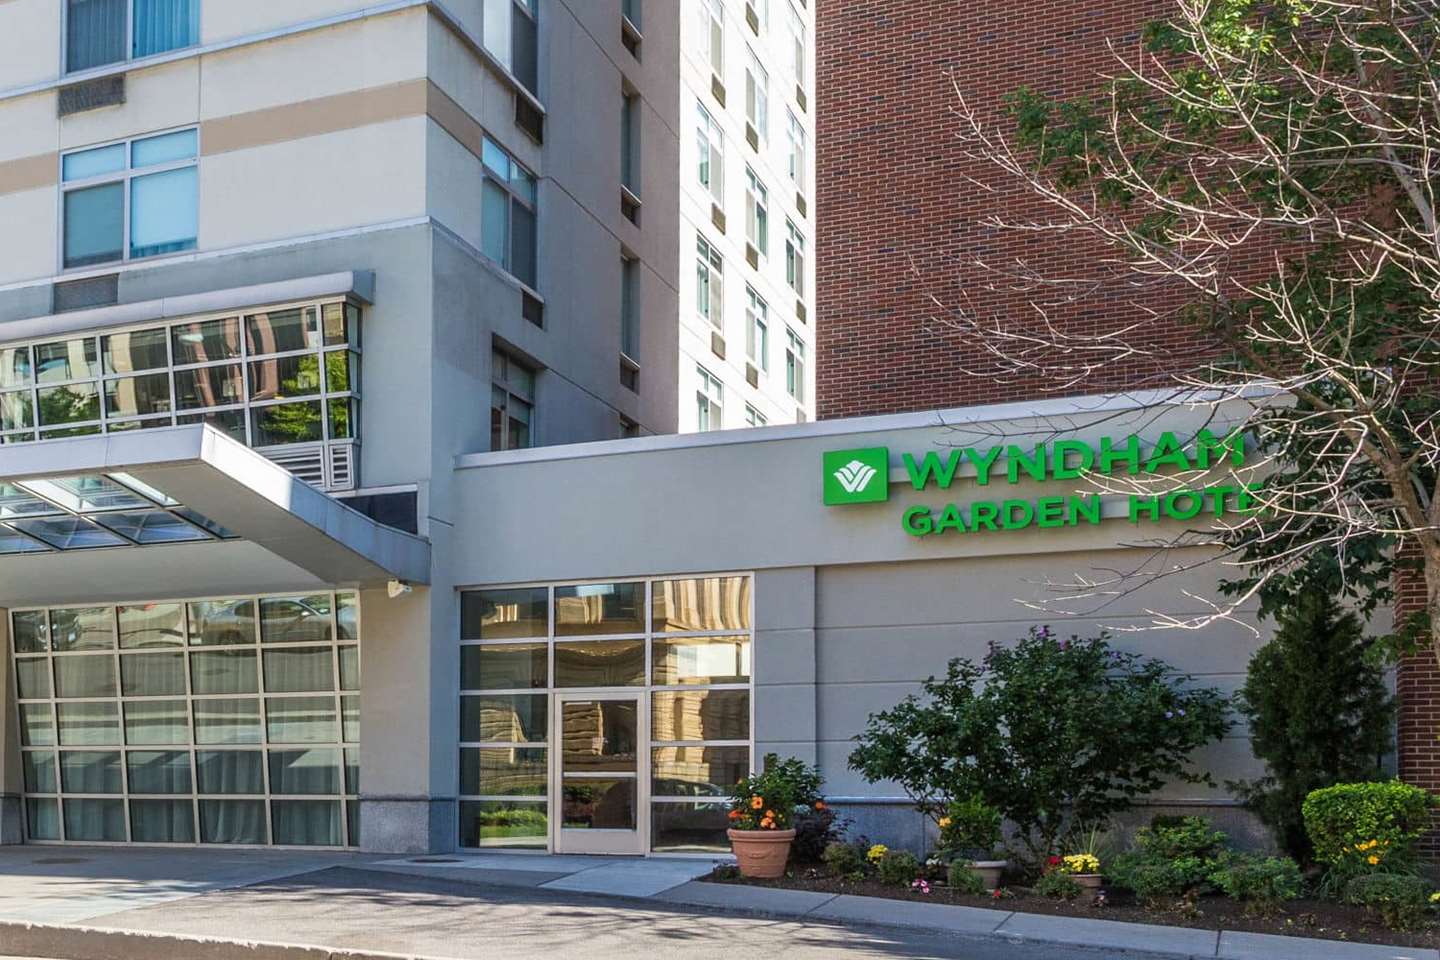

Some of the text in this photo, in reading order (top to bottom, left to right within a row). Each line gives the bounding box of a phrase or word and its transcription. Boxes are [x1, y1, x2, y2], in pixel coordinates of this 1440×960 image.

[902, 427, 1246, 491] WYNDHAM
[901, 483, 1268, 537] GARDEN HOTE
